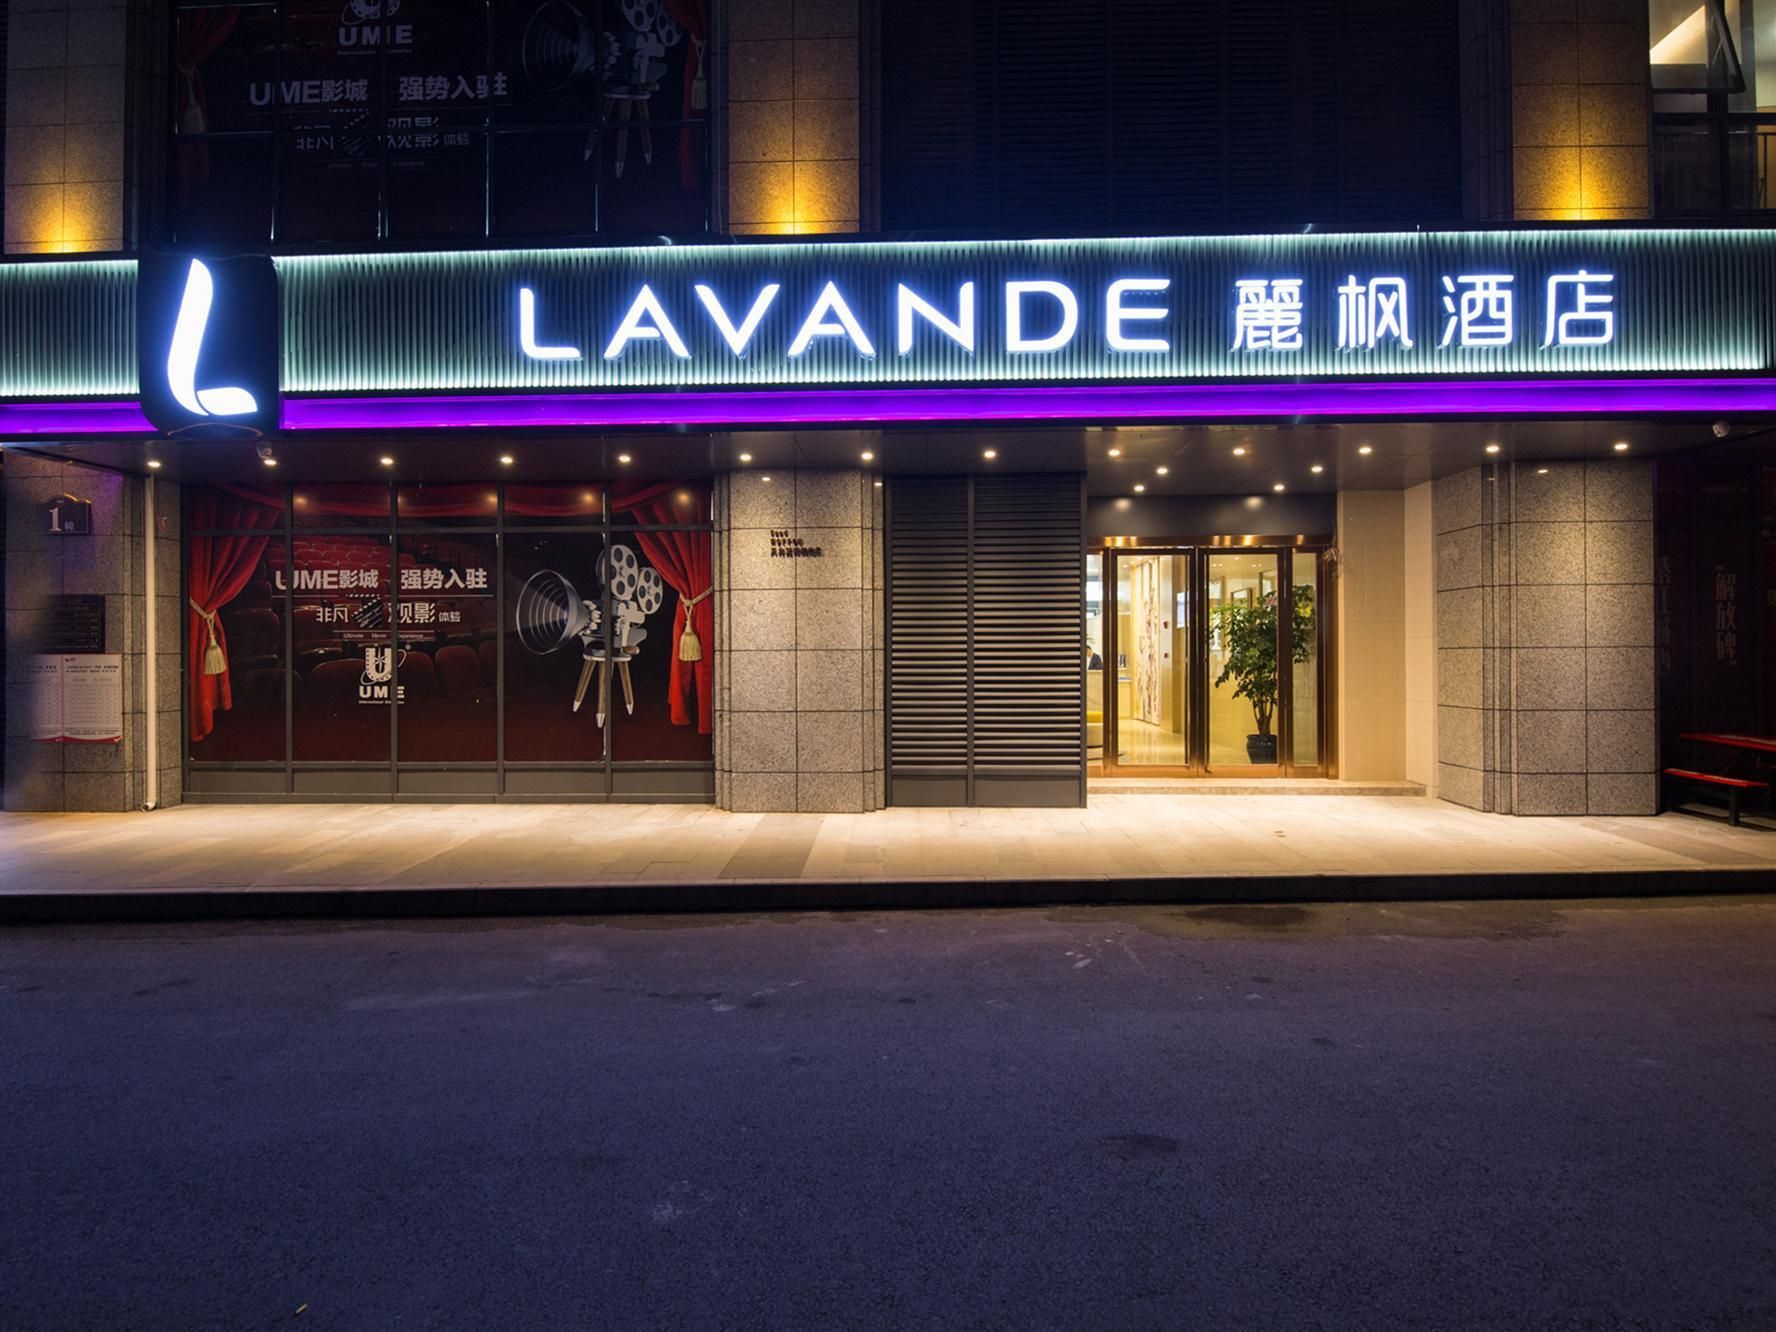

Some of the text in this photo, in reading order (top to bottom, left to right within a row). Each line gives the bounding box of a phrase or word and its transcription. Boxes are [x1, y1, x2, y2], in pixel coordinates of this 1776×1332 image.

[338, 25, 413, 46] UME
[249, 72, 508, 106] UME影城 强势入驻
[520, 270, 1614, 360] LAVANDE 麗枫酒店
[274, 568, 488, 591] UME影城 强势入驻
[315, 606, 349, 623] 非凡
[359, 685, 406, 699] UME
